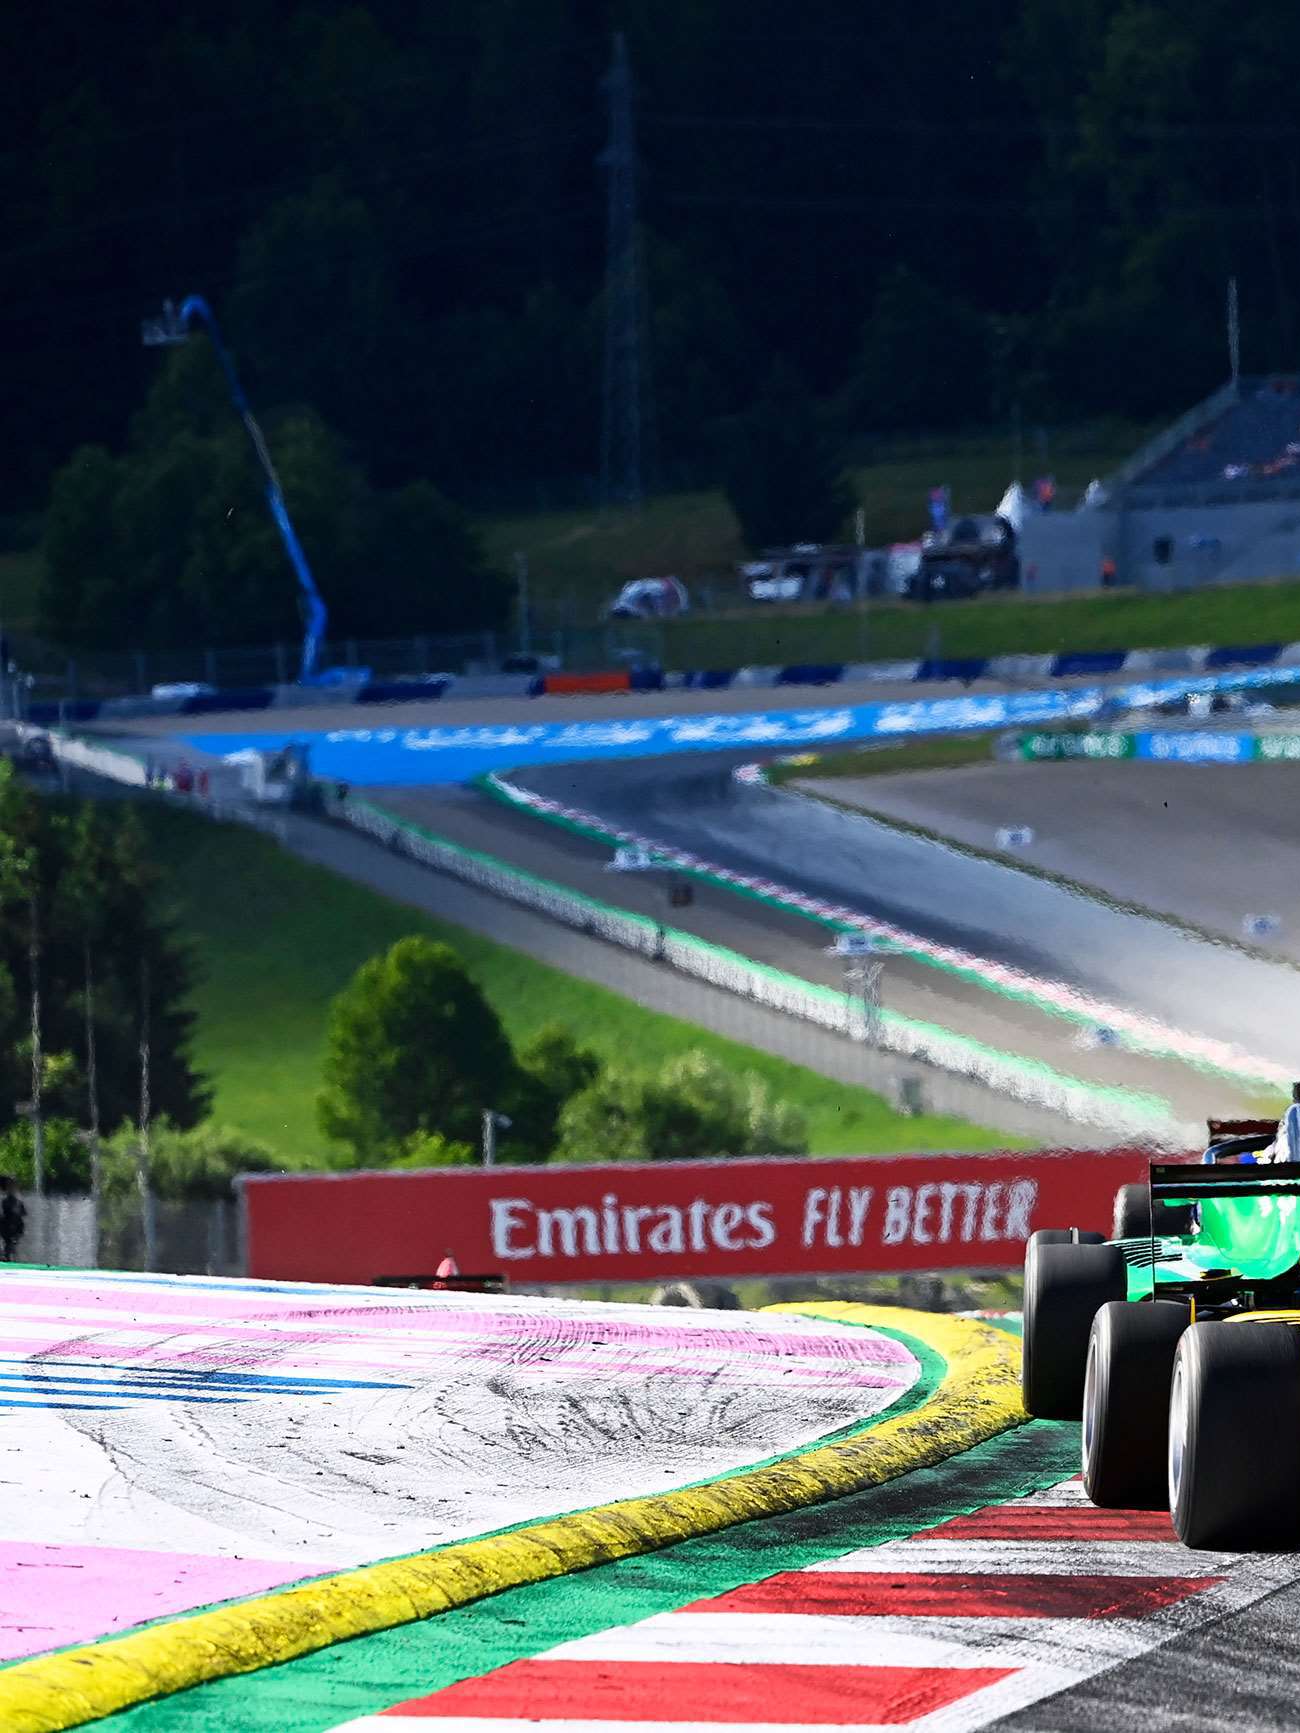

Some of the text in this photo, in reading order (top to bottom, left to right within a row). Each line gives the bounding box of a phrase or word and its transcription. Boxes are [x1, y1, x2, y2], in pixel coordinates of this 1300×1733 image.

[490, 1176, 1039, 1259] Emirates FLY BETTER
